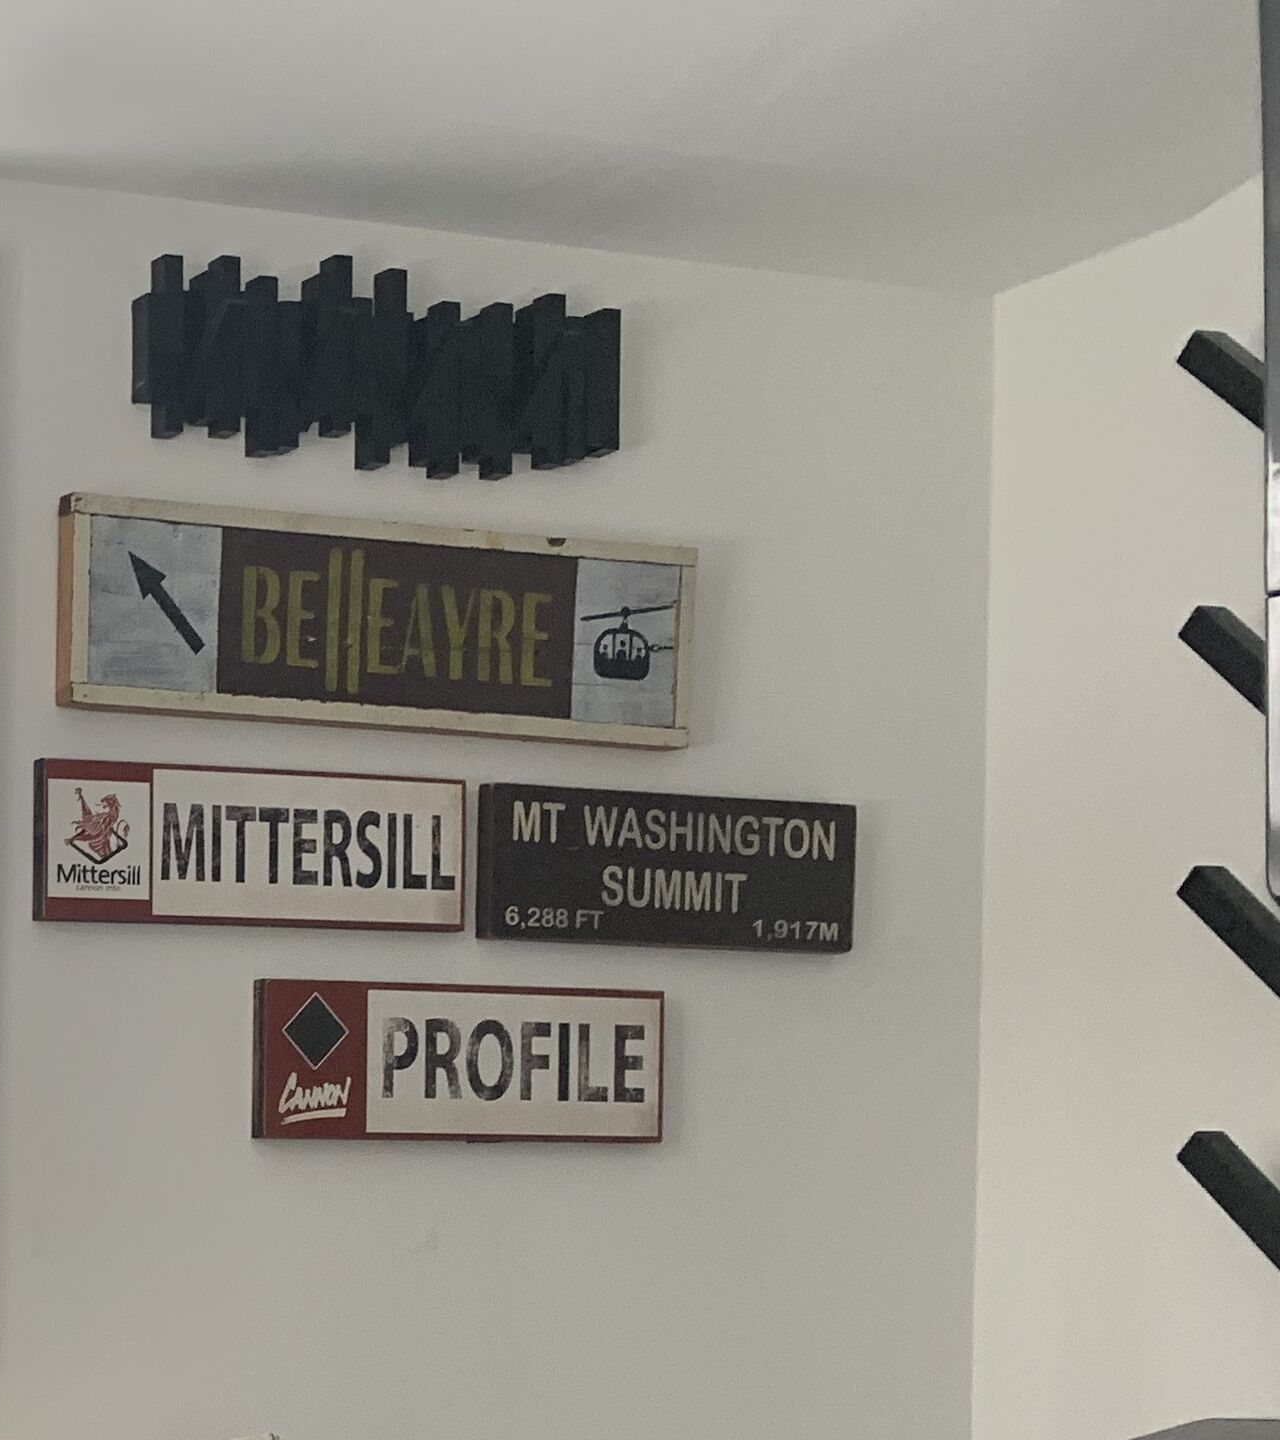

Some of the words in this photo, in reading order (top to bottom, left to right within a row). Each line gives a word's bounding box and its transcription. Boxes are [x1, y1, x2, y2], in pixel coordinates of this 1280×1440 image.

[160, 802, 456, 890] MITTERSILL
[512, 801, 566, 844] MT
[583, 804, 836, 862] WASHINGTON
[57, 863, 141, 885] Mittersill
[601, 865, 748, 915] SUMMIT
[504, 906, 569, 930] 6,288
[575, 909, 604, 930] FT
[751, 919, 839, 942] 1,917M
[382, 1016, 645, 1103] PROFILE
